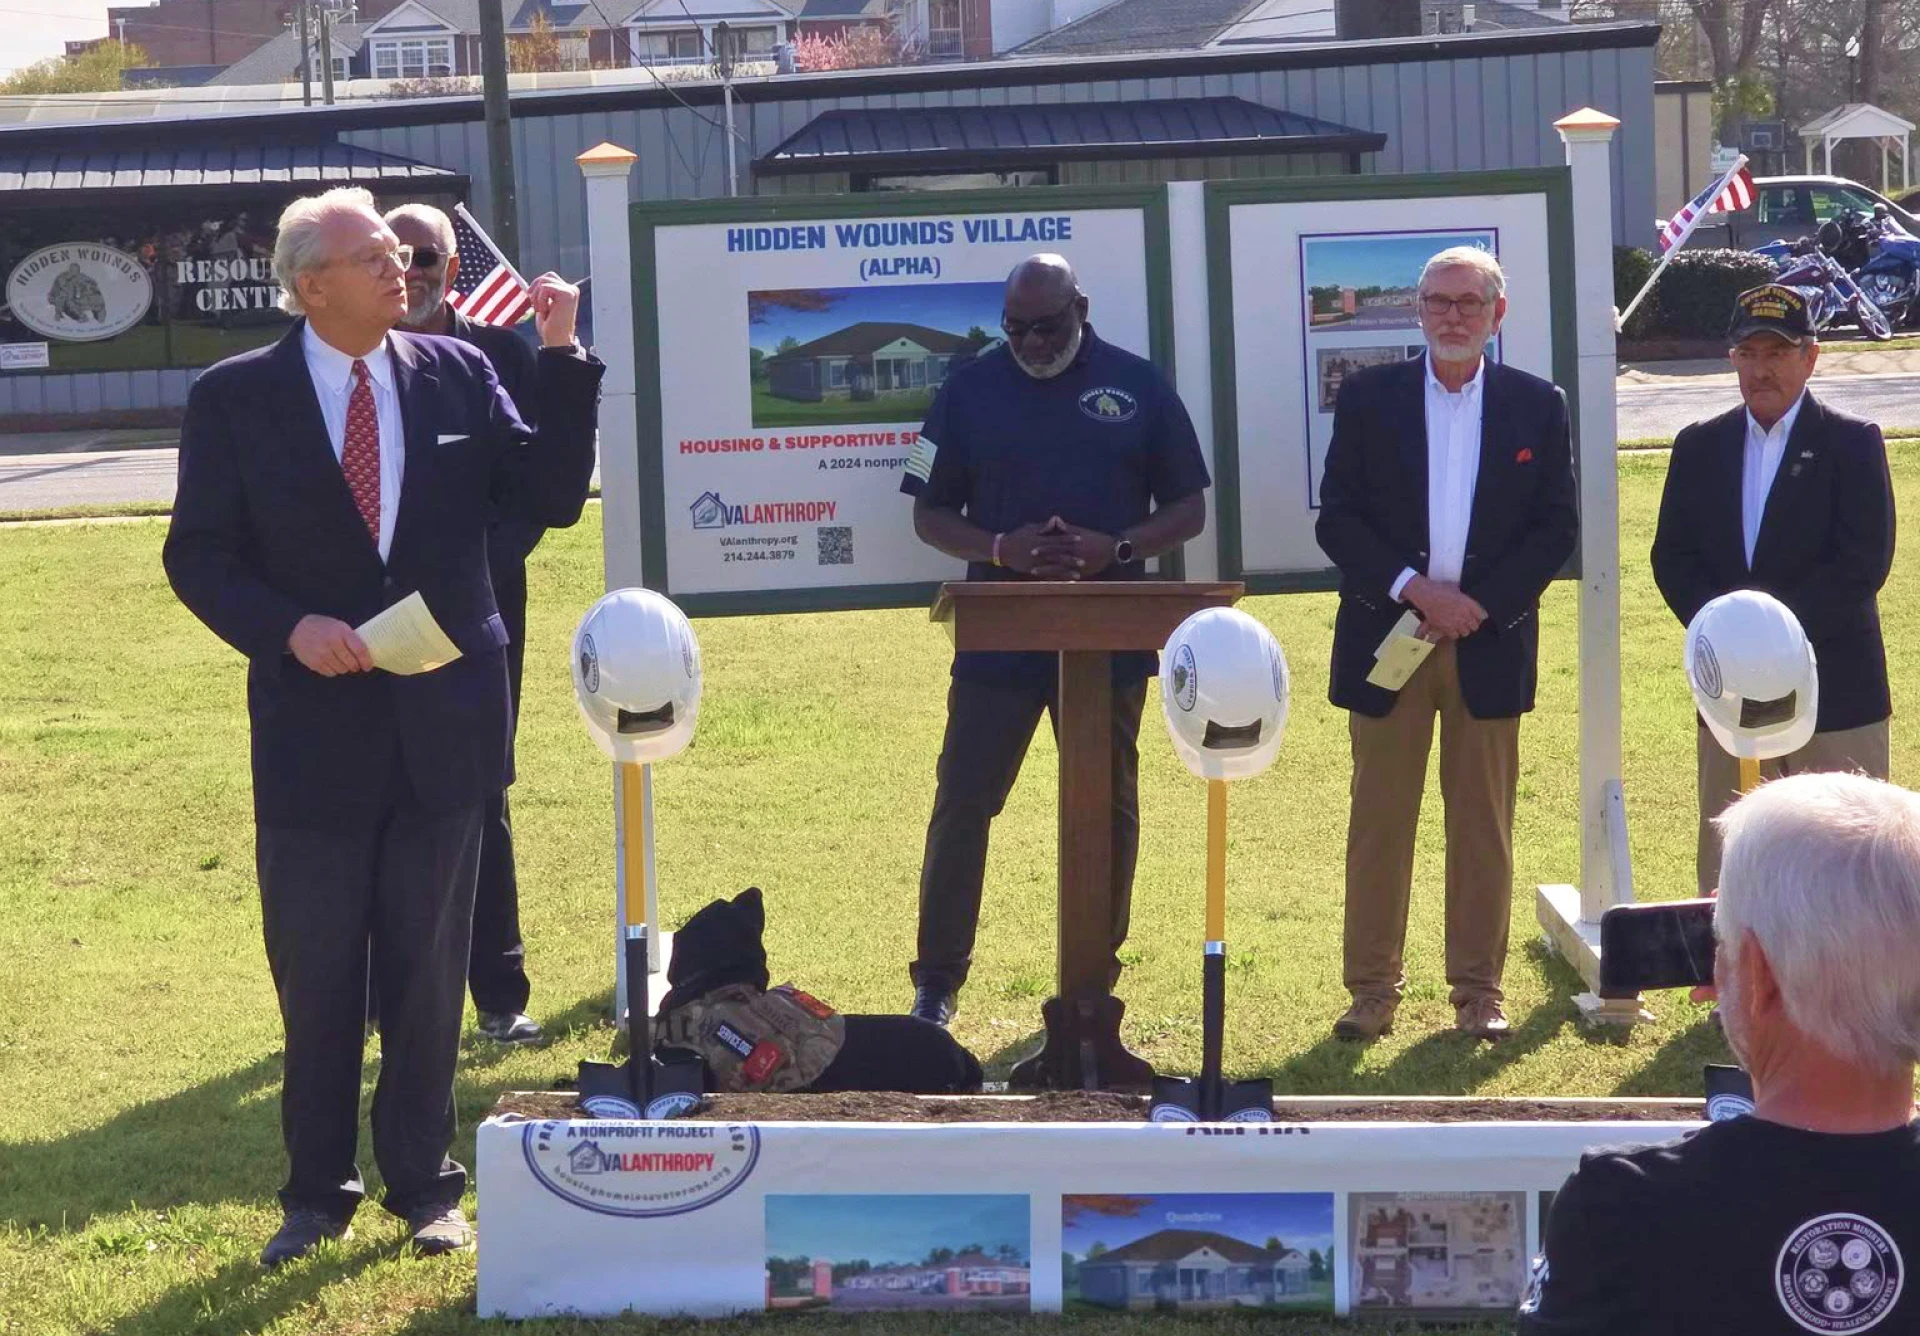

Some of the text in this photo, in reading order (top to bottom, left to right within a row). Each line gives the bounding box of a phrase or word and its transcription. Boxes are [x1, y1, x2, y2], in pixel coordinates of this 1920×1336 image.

[727, 216, 1072, 252] HIDDEN WOUNDS VILLAGE
[16, 247, 140, 286] HIDDEN WOUNDS
[859, 256, 941, 281] (ALPHA)
[679, 438, 764, 454] HOUSING
[768, 437, 781, 450] &
[785, 432, 896, 449] SUPPORTIVE
[818, 459, 828, 470] A
[831, 458, 861, 470] 2024
[724, 501, 837, 525] VALANTHROPY
[723, 550, 796, 562] 214.244.3879
[567, 1126, 716, 1138] A NONPROFIT PROJECT
[602, 1153, 716, 1172] VALANTHROPY
[1790, 1221, 1890, 1254] RESTORATION MINISTRY
